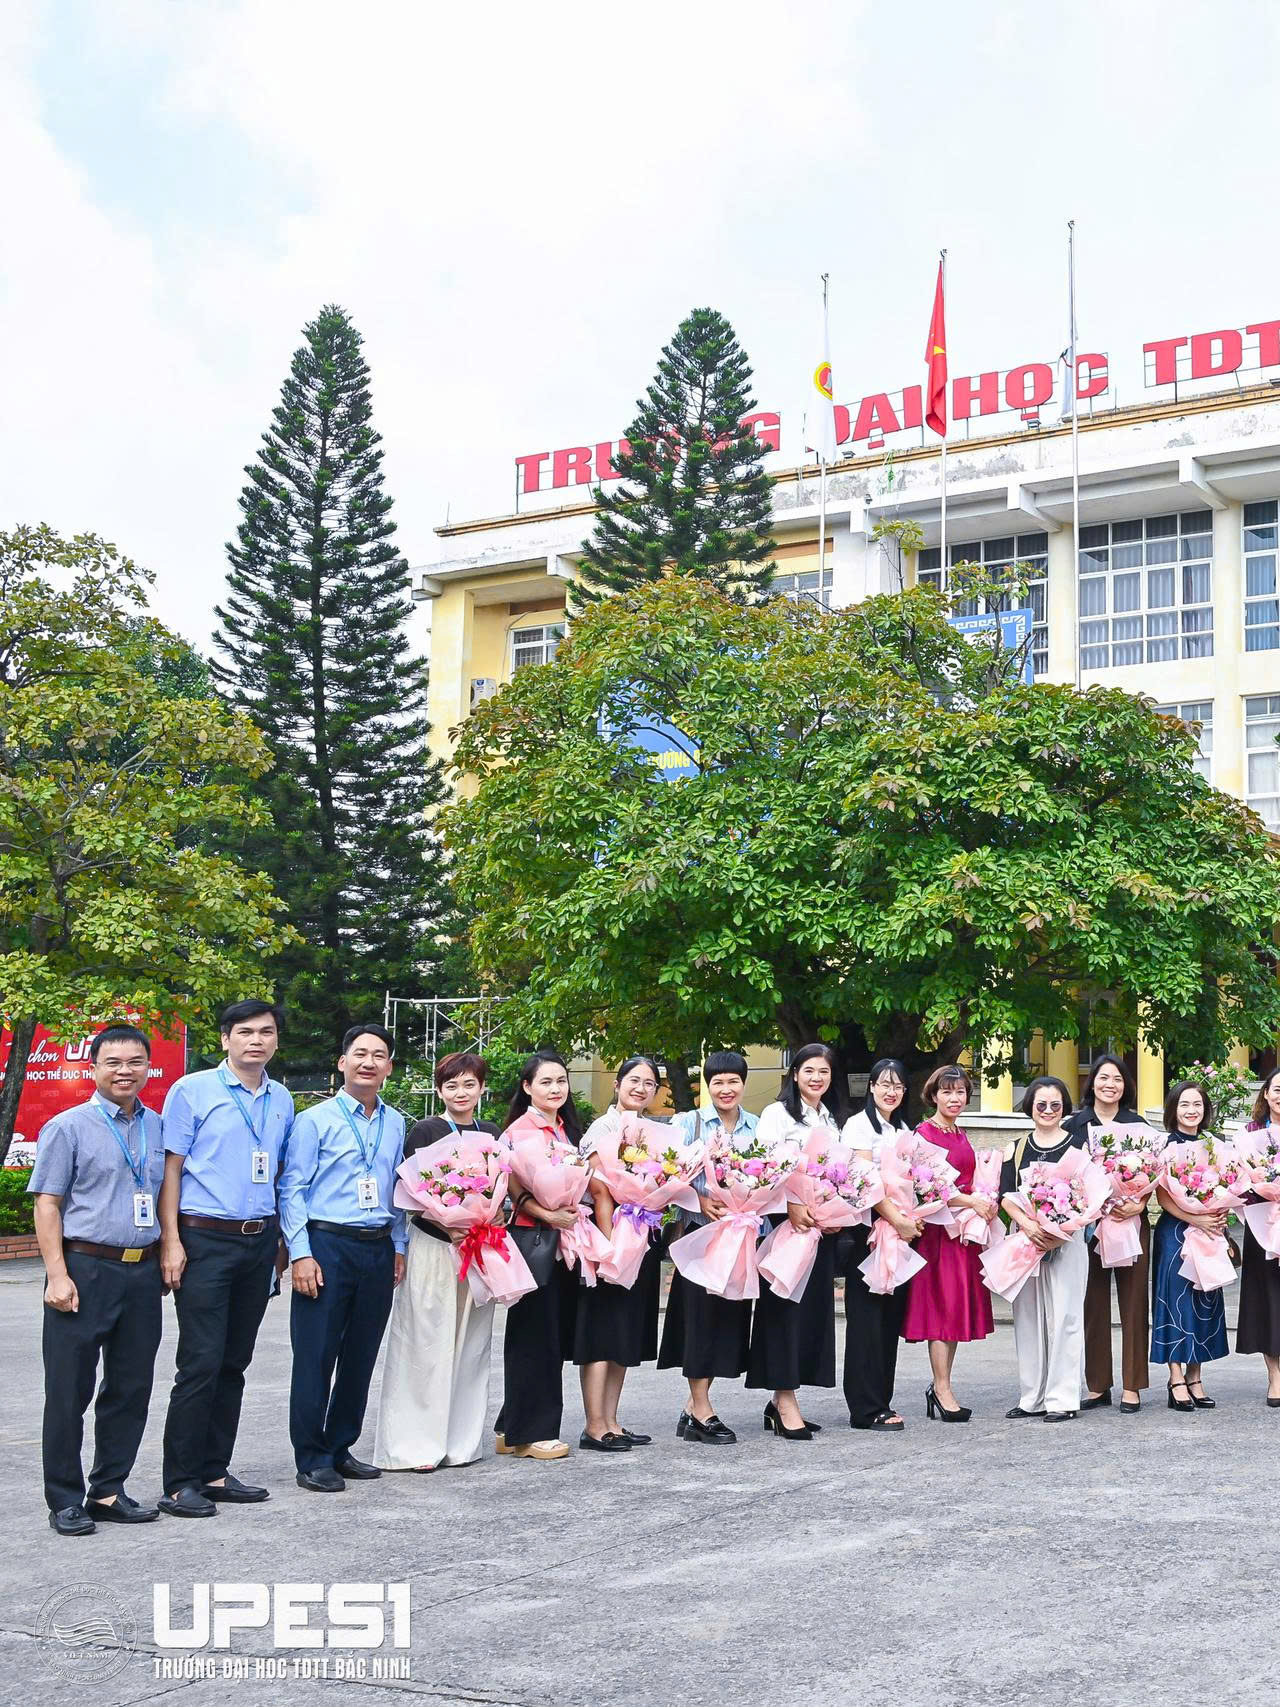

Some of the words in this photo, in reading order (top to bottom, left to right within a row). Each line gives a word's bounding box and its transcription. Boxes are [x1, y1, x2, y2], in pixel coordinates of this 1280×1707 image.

[953, 353, 1109, 421] HỌC
[28, 1040, 59, 1066] chọn
[27, 1071, 46, 1083] HỌC
[47, 1066, 61, 1080] THỂ
[62, 1070, 80, 1082] DỤC
